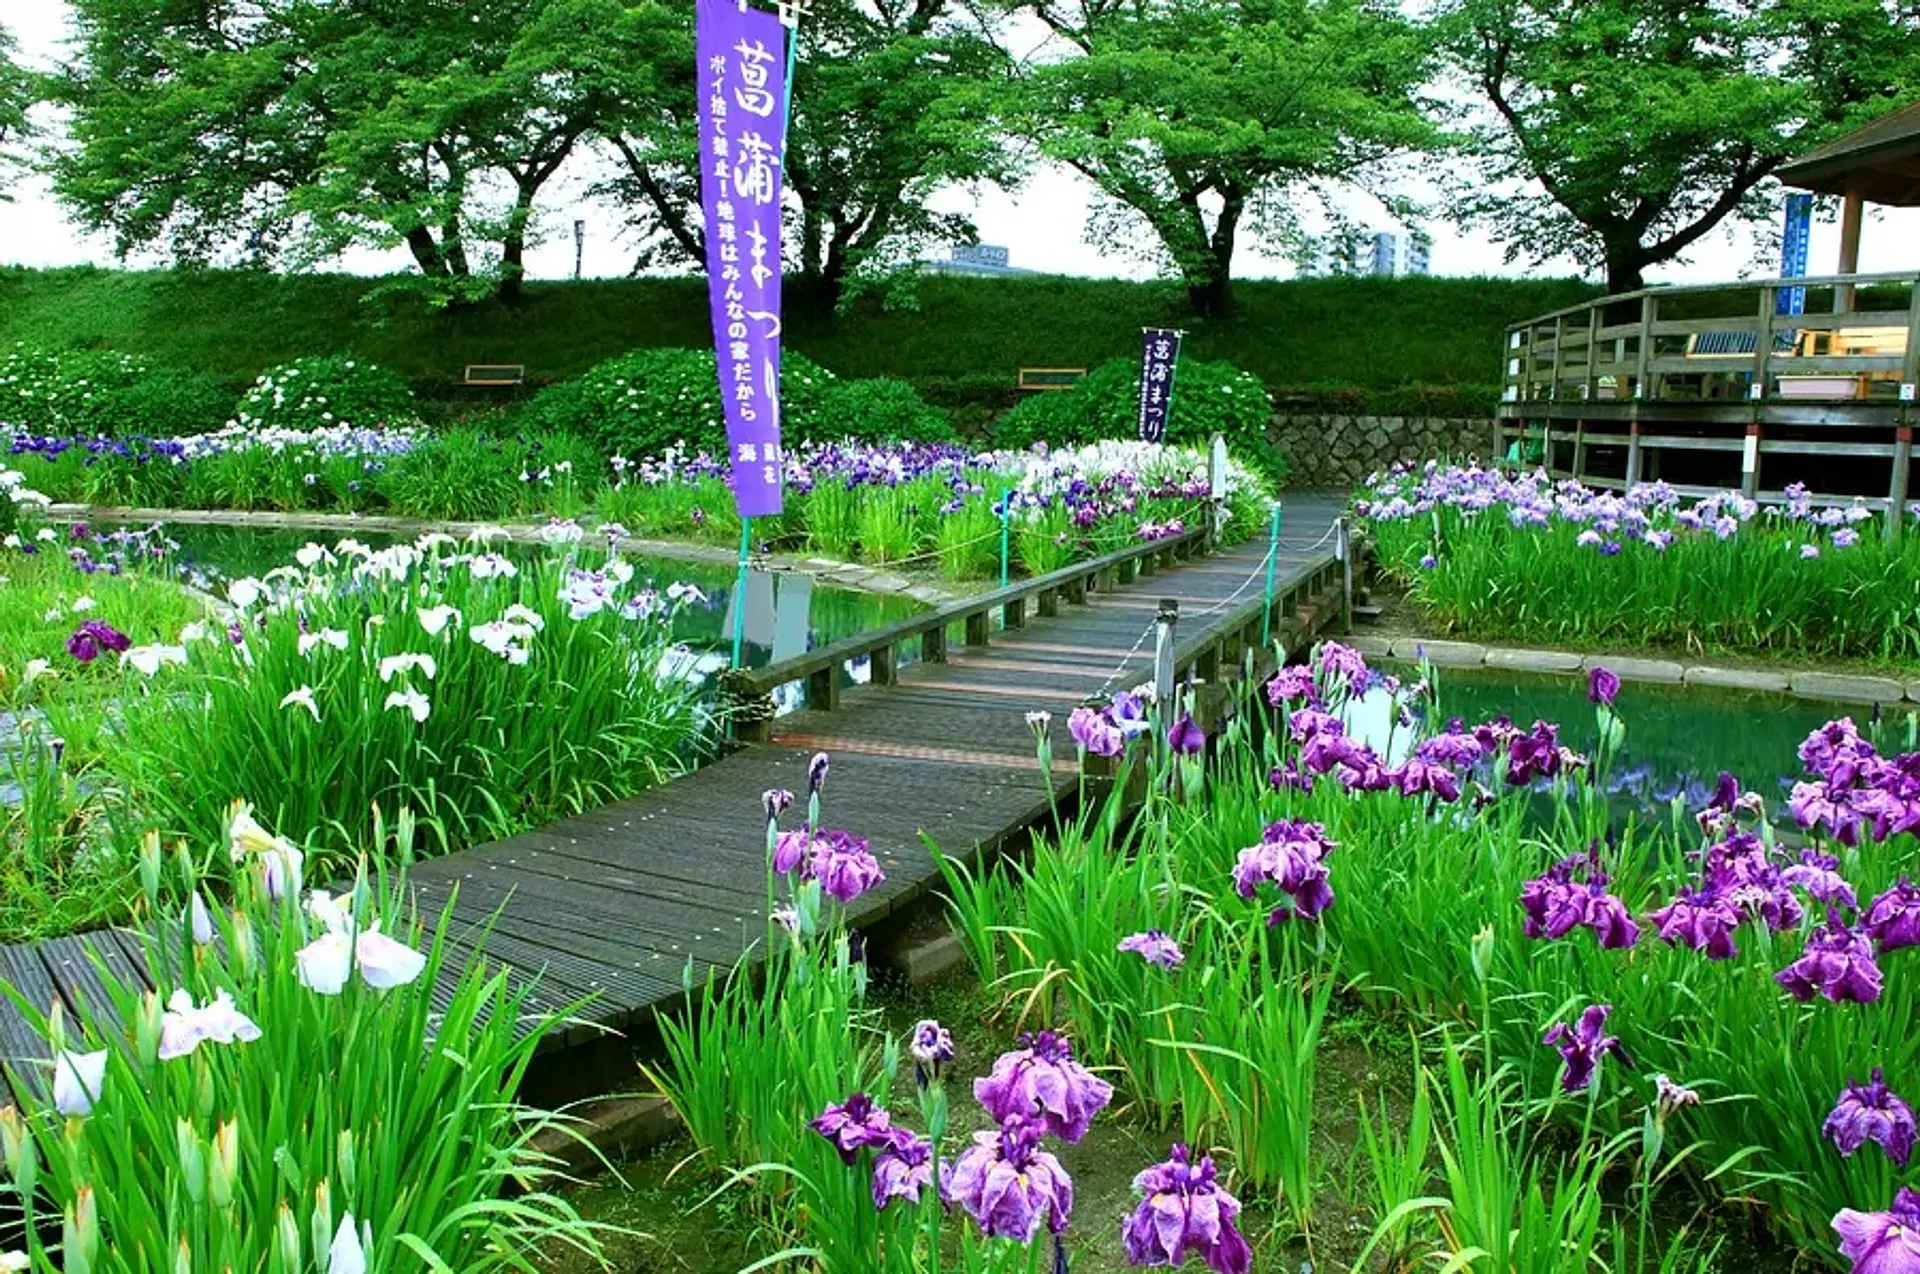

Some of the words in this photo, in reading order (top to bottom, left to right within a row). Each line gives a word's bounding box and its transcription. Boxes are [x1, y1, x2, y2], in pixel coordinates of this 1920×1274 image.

[733, 38, 781, 427] 菖蒲まつり
